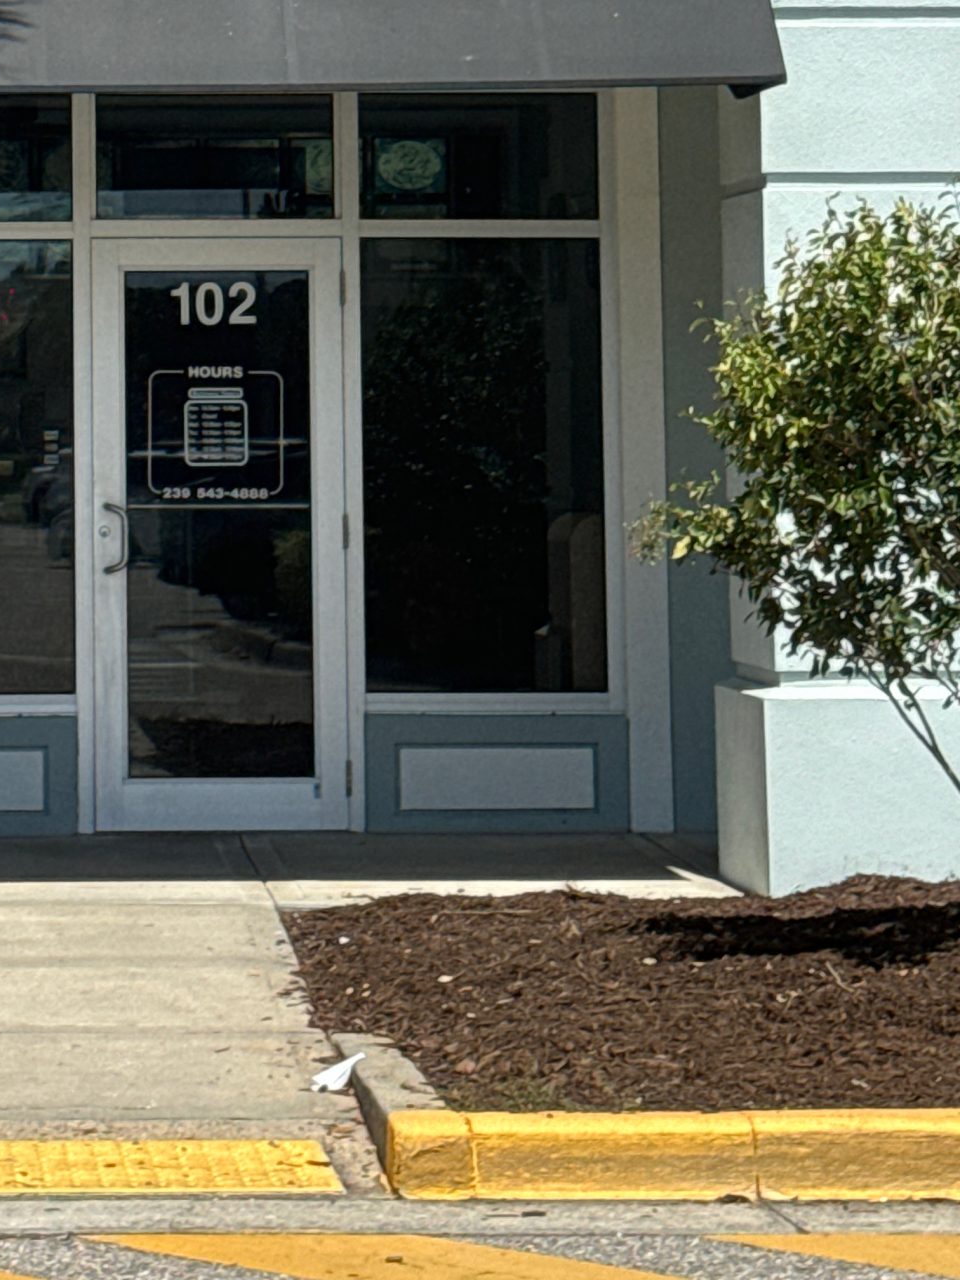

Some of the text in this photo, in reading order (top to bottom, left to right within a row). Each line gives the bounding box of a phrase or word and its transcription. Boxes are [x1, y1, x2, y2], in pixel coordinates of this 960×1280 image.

[170, 281, 257, 326] 102
[188, 366, 244, 379] HOURS
[162, 487, 191, 499] 239
